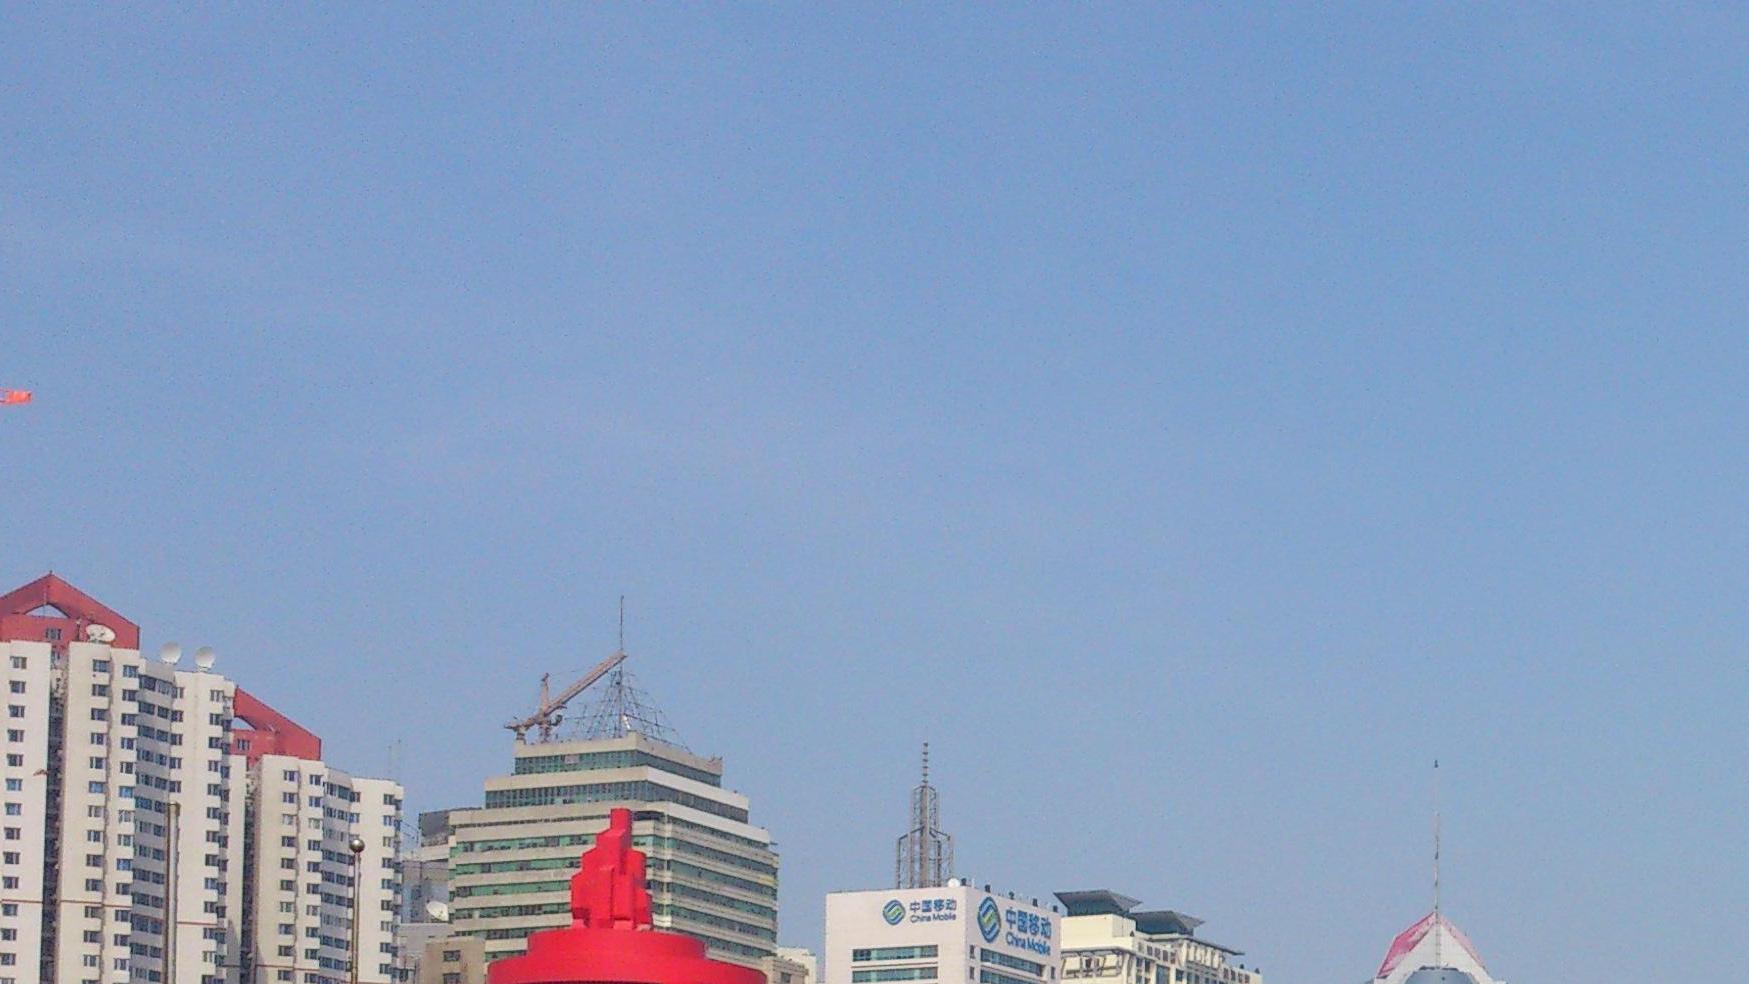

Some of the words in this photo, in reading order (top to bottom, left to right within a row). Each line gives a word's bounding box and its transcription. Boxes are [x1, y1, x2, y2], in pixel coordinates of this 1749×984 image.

[910, 899, 957, 913] 中国移动
[910, 914, 932, 923] China
[933, 912, 957, 921] Mobile
[1005, 907, 1052, 939] 中国移动
